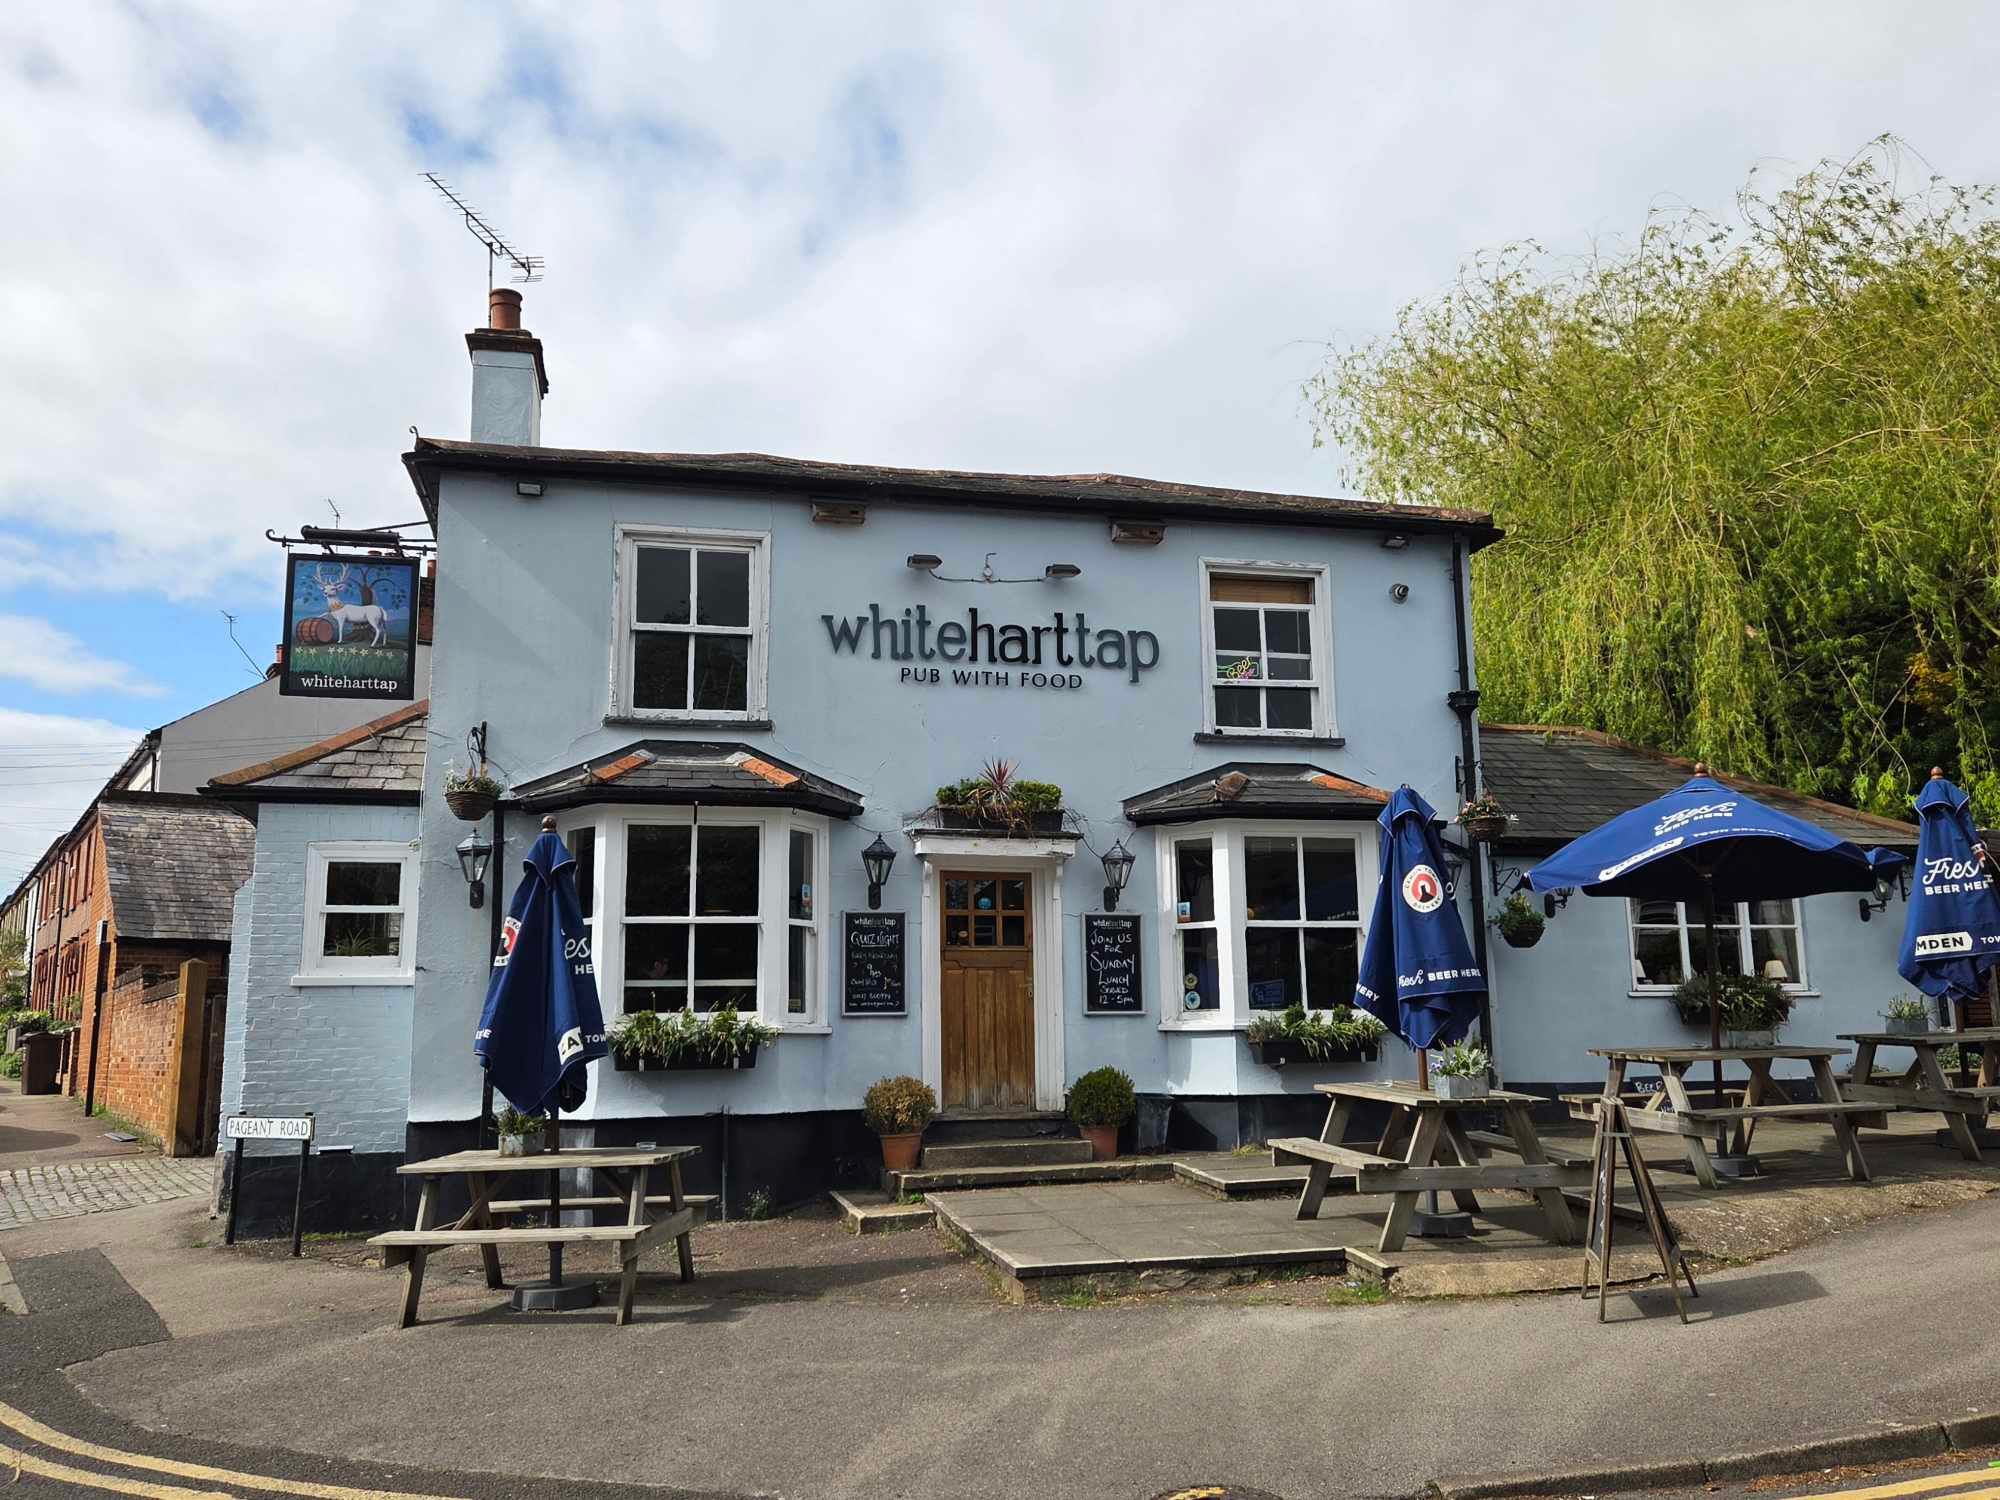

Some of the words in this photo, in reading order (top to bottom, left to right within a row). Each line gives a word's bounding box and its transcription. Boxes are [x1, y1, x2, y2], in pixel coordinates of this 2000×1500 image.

[821, 603, 1160, 683] whiteharttap
[301, 674, 398, 692] whiteharttap
[900, 667, 940, 683] PUB
[953, 669, 1009, 686] WITH
[1021, 672, 1083, 689] FOOD
[1925, 884, 1961, 895] BEER
[1117, 934, 1133, 943] US
[1104, 945, 1123, 953] FOR
[1090, 951, 1135, 974] SUNDAY
[1098, 970, 1129, 987] LUNCH
[1428, 970, 1459, 981] BEER
[229, 1120, 274, 1136] PAGEANT
[280, 1121, 309, 1136] ROAD
